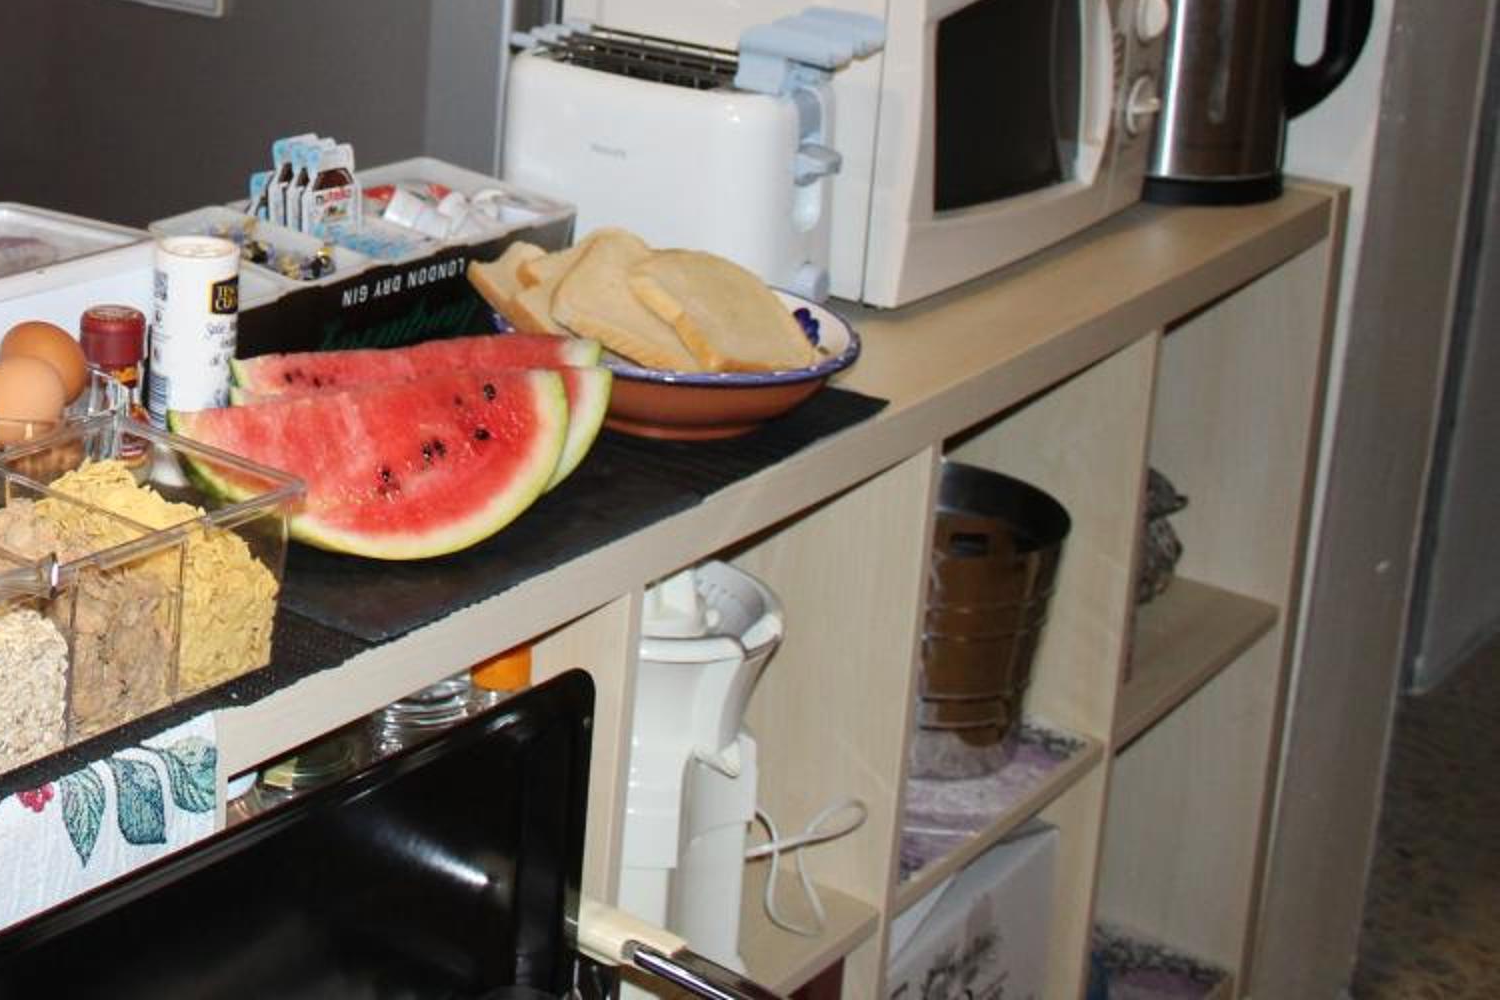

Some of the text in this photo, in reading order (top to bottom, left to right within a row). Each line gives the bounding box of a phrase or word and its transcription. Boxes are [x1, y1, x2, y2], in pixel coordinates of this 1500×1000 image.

[341, 257, 466, 308] LONDON DRY GIN
